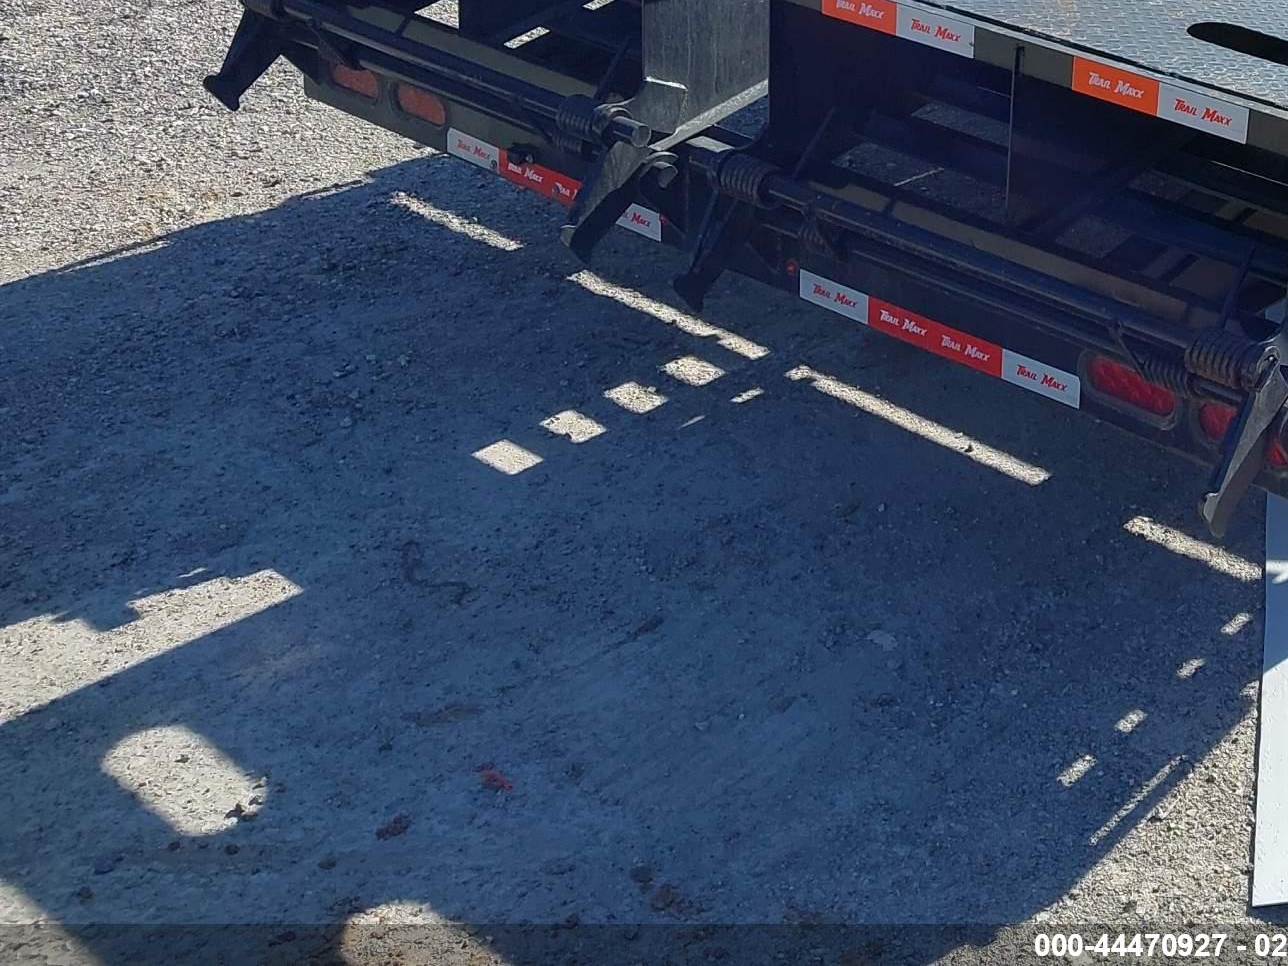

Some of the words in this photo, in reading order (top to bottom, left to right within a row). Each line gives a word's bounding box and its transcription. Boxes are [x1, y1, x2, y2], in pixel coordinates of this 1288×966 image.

[1088, 71, 1111, 90] TRAIL
[1113, 79, 1145, 99] MAXX
[1173, 98, 1198, 117] TRAIL
[1201, 107, 1233, 127] MAXX
[879, 309, 900, 326] TRAIL
[901, 317, 929, 337] MAXX
[940, 334, 961, 352] TRAIL
[963, 343, 991, 363] MAXX
[1015, 363, 1037, 382] TRAIL
[1039, 372, 1068, 393] MAXX
